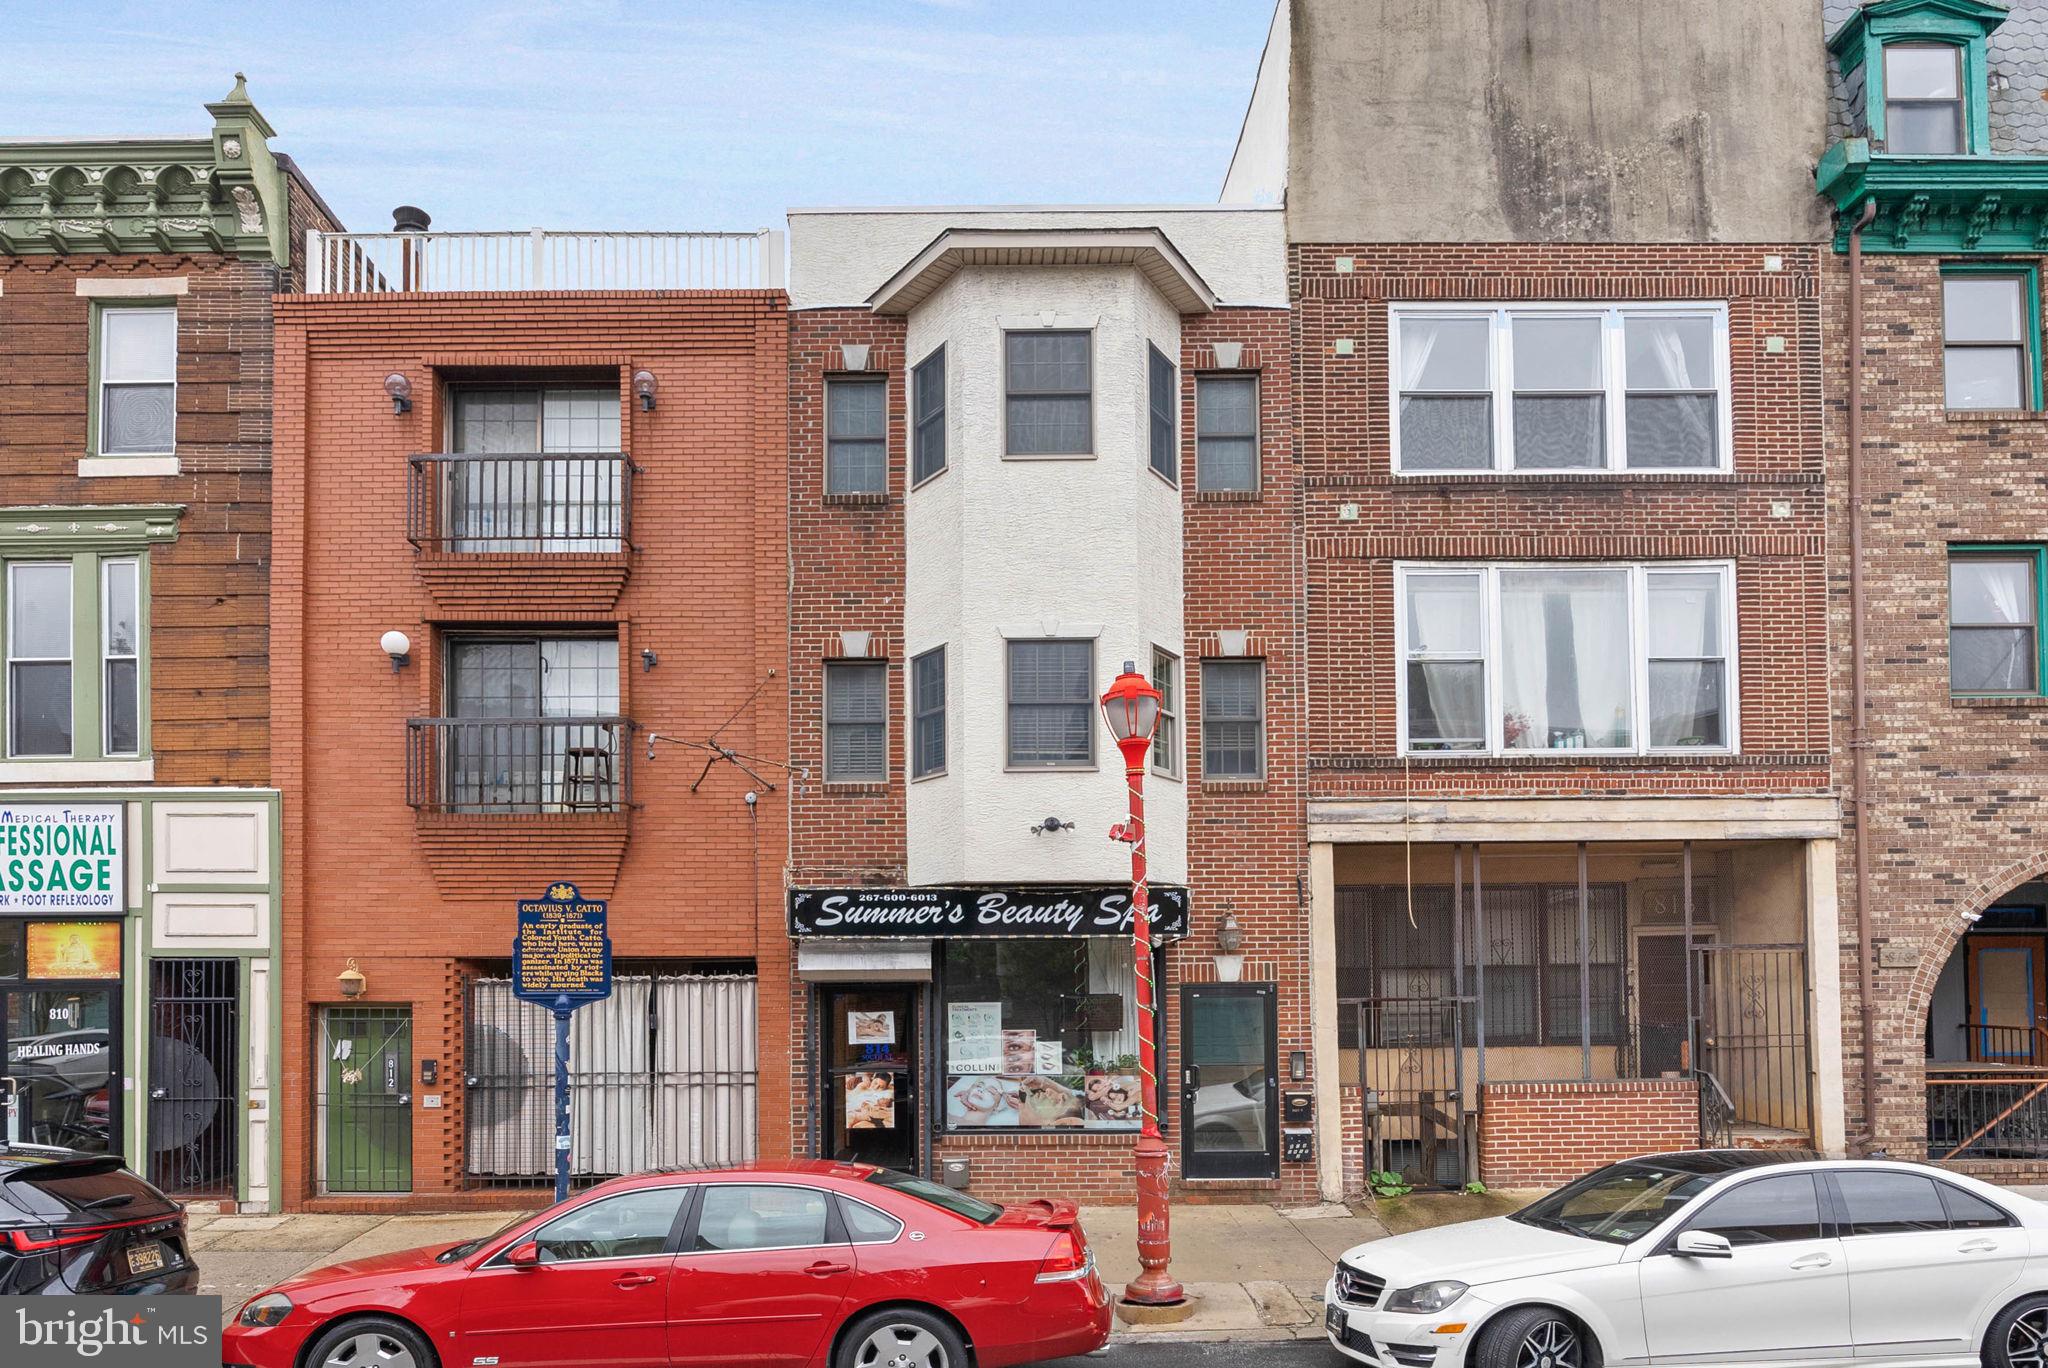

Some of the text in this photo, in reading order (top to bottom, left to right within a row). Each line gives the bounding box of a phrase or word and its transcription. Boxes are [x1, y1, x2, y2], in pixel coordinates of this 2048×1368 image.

[0, 859, 111, 892] SSAGE
[22, 894, 47, 906] FOOT
[50, 894, 114, 906] REFLEXOLOGY
[858, 893, 938, 902] 267-600-6013
[522, 904, 603, 913] OCTAVIUS V. CATTO
[1656, 894, 1696, 914] 81
[815, 892, 1163, 933] Summer's Beauty Spa
[558, 923, 593, 931] graduate
[580, 946, 603, 954] Army
[571, 964, 582, 972] by
[554, 970, 579, 978] urging
[49, 1008, 69, 1020] 810
[17, 1042, 101, 1058] HEALING HANDS
[865, 1043, 889, 1055] 814
[956, 1064, 996, 1072] COLLIN
[130, 1223, 174, 1236] LEXUS
[472, 1356, 500, 1366] SS
